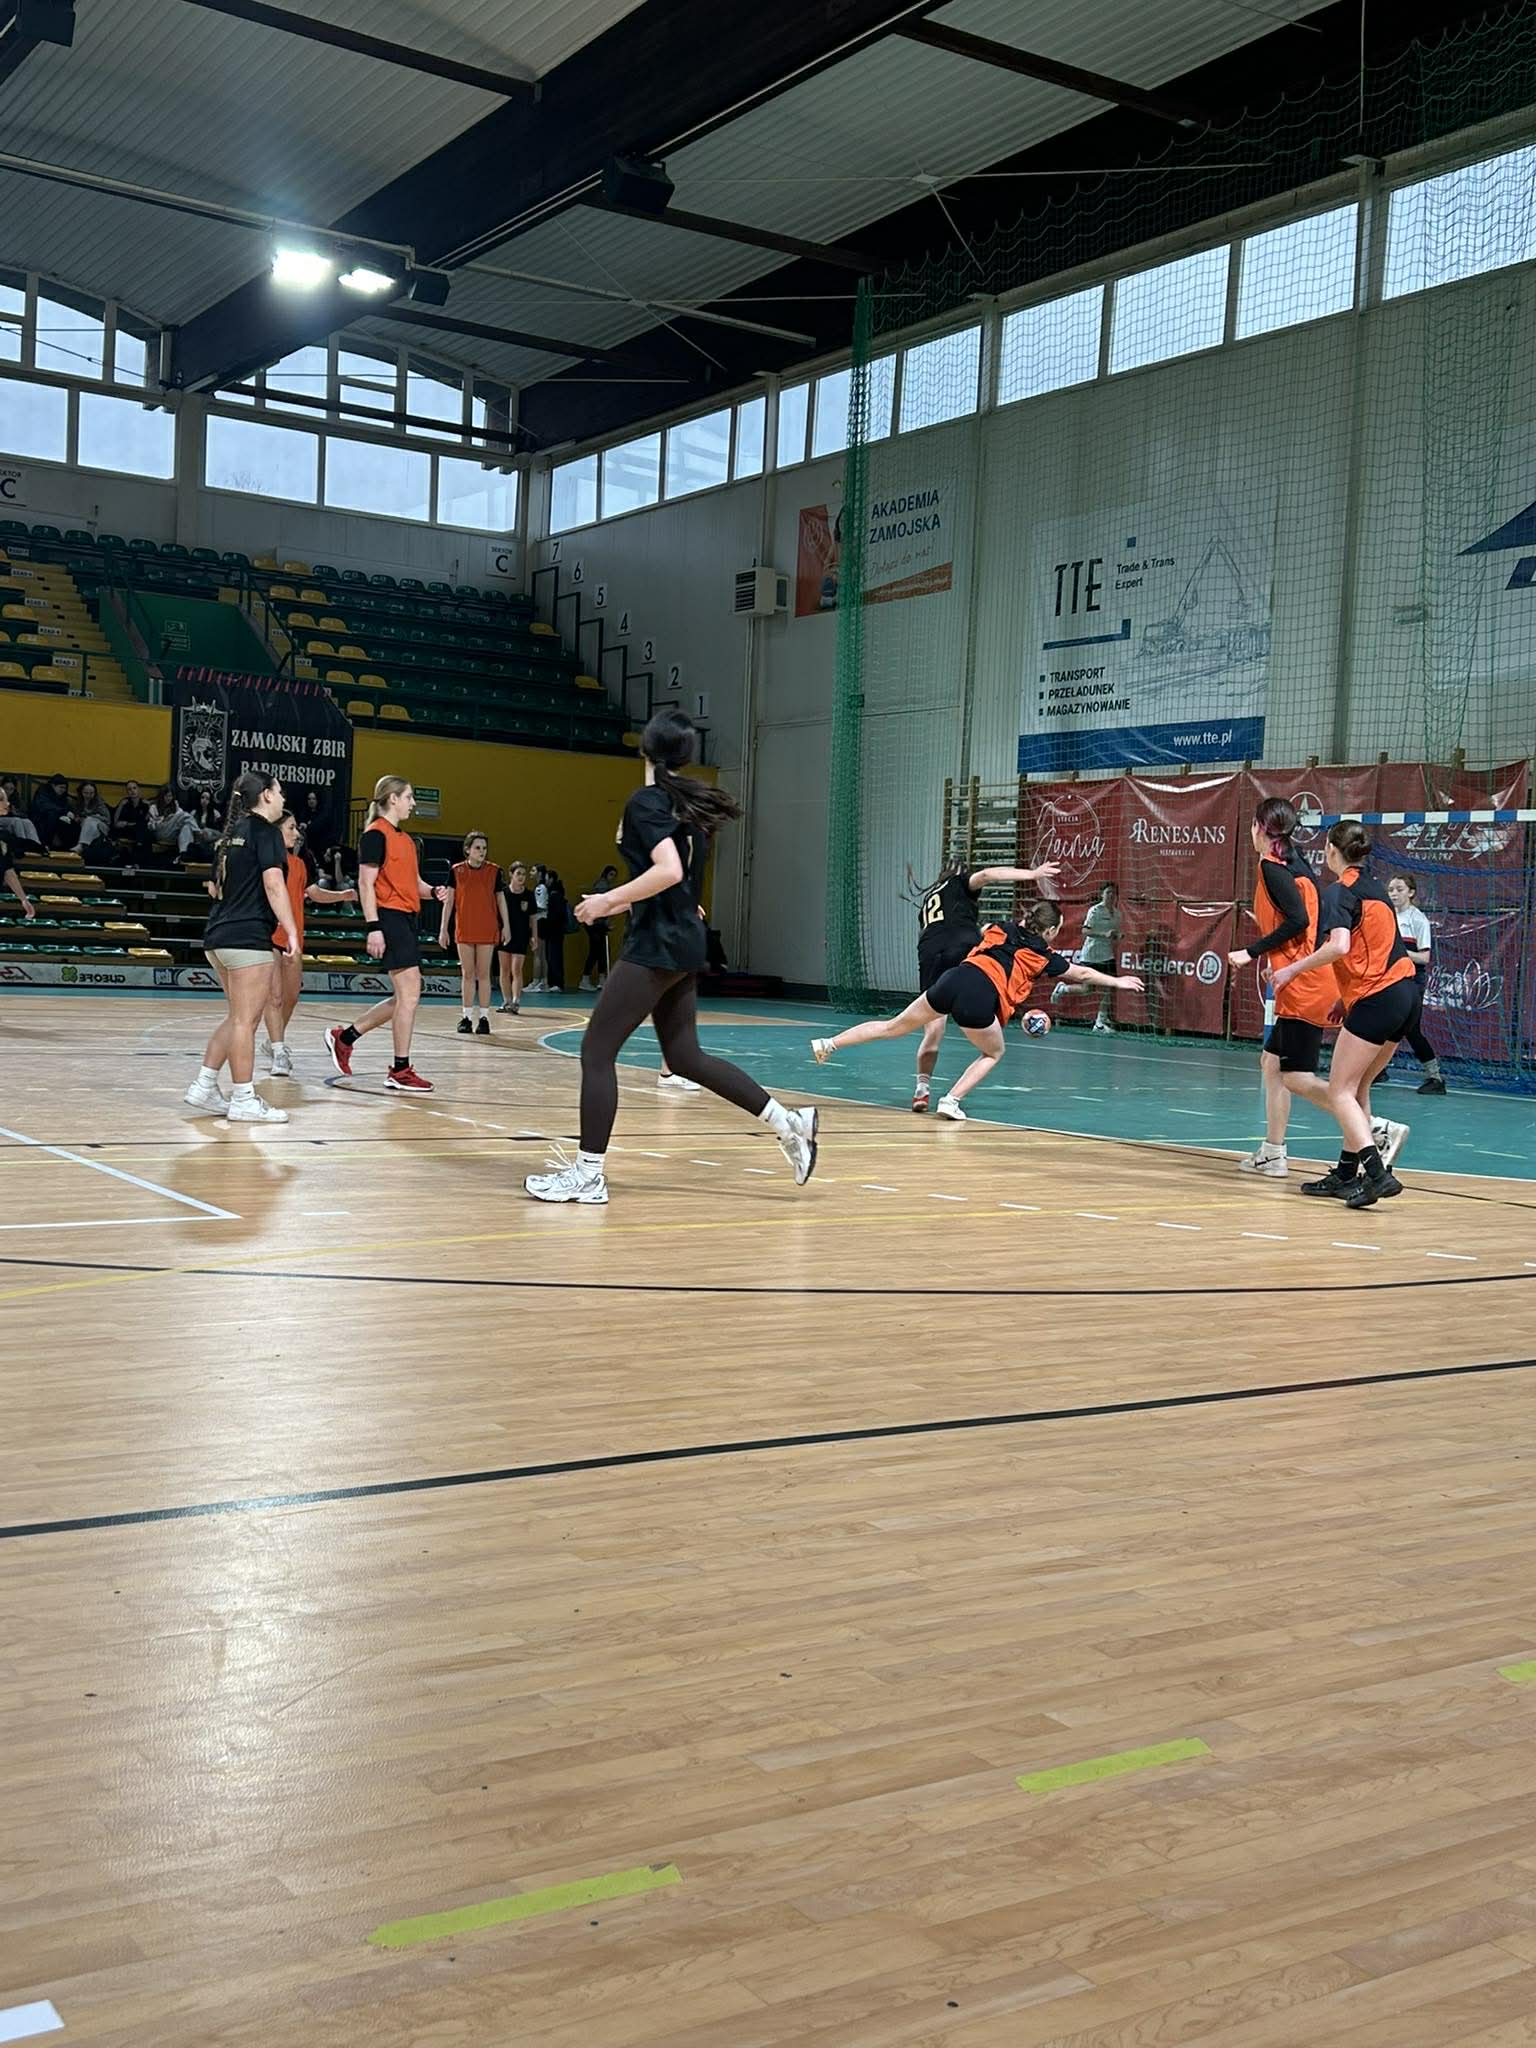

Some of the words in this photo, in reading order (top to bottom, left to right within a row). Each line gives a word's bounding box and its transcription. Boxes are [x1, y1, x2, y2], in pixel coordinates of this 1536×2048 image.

[1, 478, 16, 499] C
[871, 489, 940, 520] AKADEMIA
[869, 513, 941, 544] ZAMOJSKA
[553, 542, 560, 560] 7
[496, 555, 508, 573] C
[574, 562, 581, 581] 6
[1117, 563, 1140, 575] Trade
[1143, 561, 1148, 569] &
[1151, 557, 1175, 568] Trans
[1055, 558, 1103, 617] TTE
[1115, 577, 1143, 590] Expert
[596, 587, 604, 606] 5
[620, 613, 628, 632] 4
[644, 641, 653, 660] 3
[671, 667, 679, 686] 2
[1049, 667, 1106, 684] TRANSPORT
[1048, 683, 1115, 700] PRZEŁADUNEK
[698, 696, 704, 715] 1
[1046, 699, 1131, 717] MAGAZYNOWANIE
[231, 729, 307, 756] ZAMOJSKI
[312, 738, 346, 760] ZBIR
[1173, 729, 1233, 748] www.tte.pl
[241, 760, 336, 787] BARBERSHOP
[1129, 818, 1226, 845] RENESANS
[922, 892, 945, 930] 12
[1121, 952, 1196, 977] E.Leclerc
